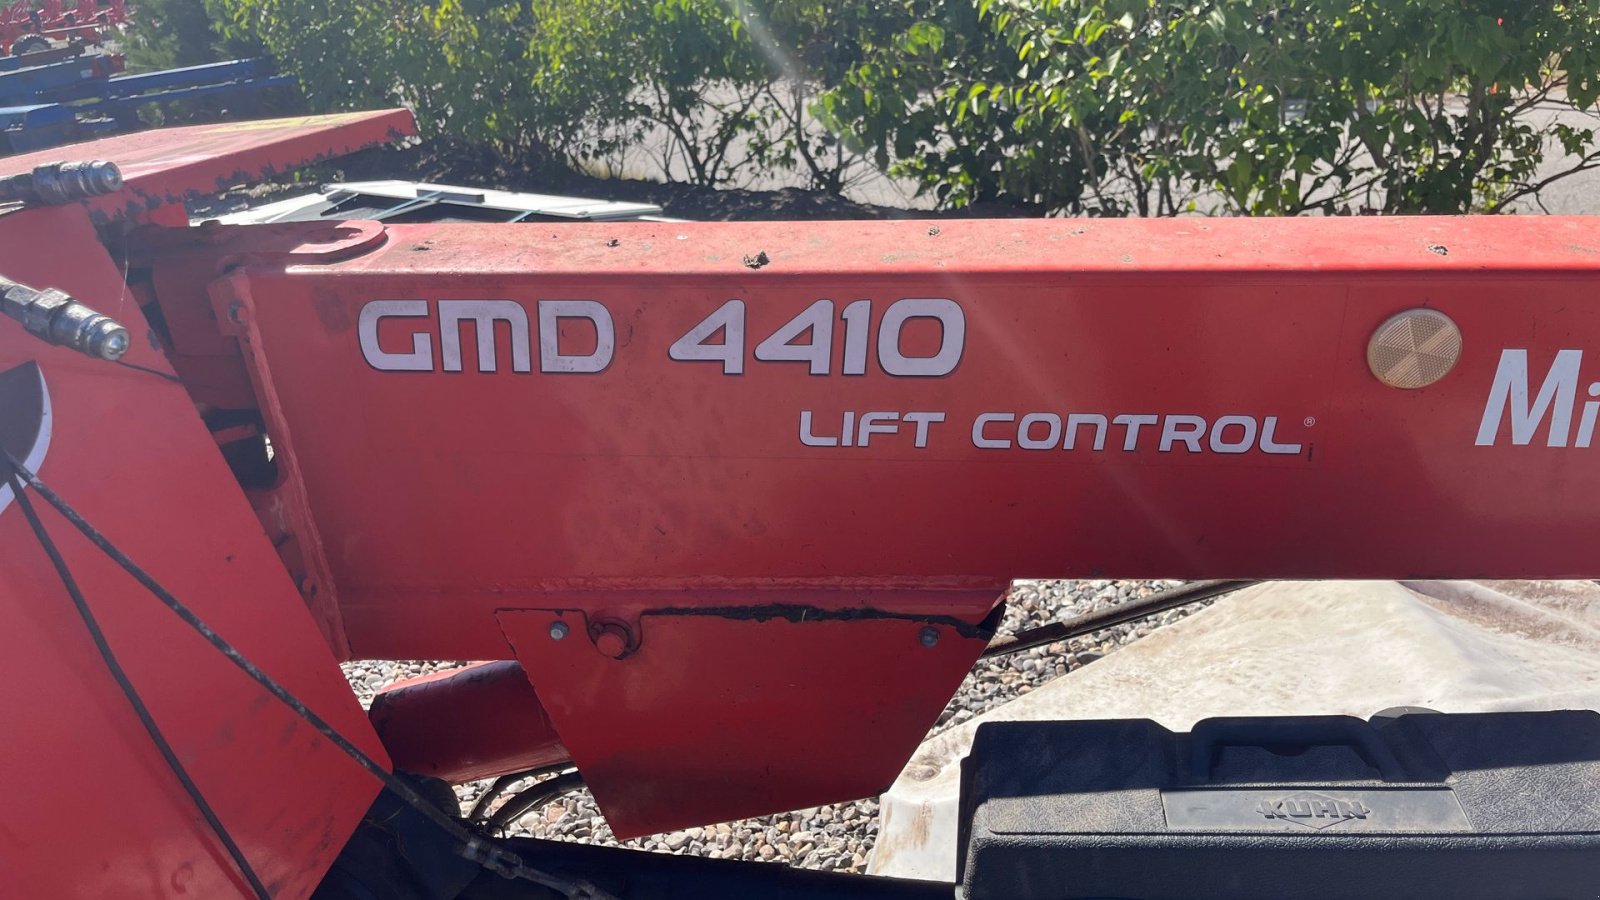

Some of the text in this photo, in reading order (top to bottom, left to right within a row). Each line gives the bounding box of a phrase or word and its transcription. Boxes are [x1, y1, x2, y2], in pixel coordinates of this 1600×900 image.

[357, 298, 966, 377] GMD 4410
[799, 410, 946, 448] LIFT
[1259, 799, 1368, 820] KUHN
